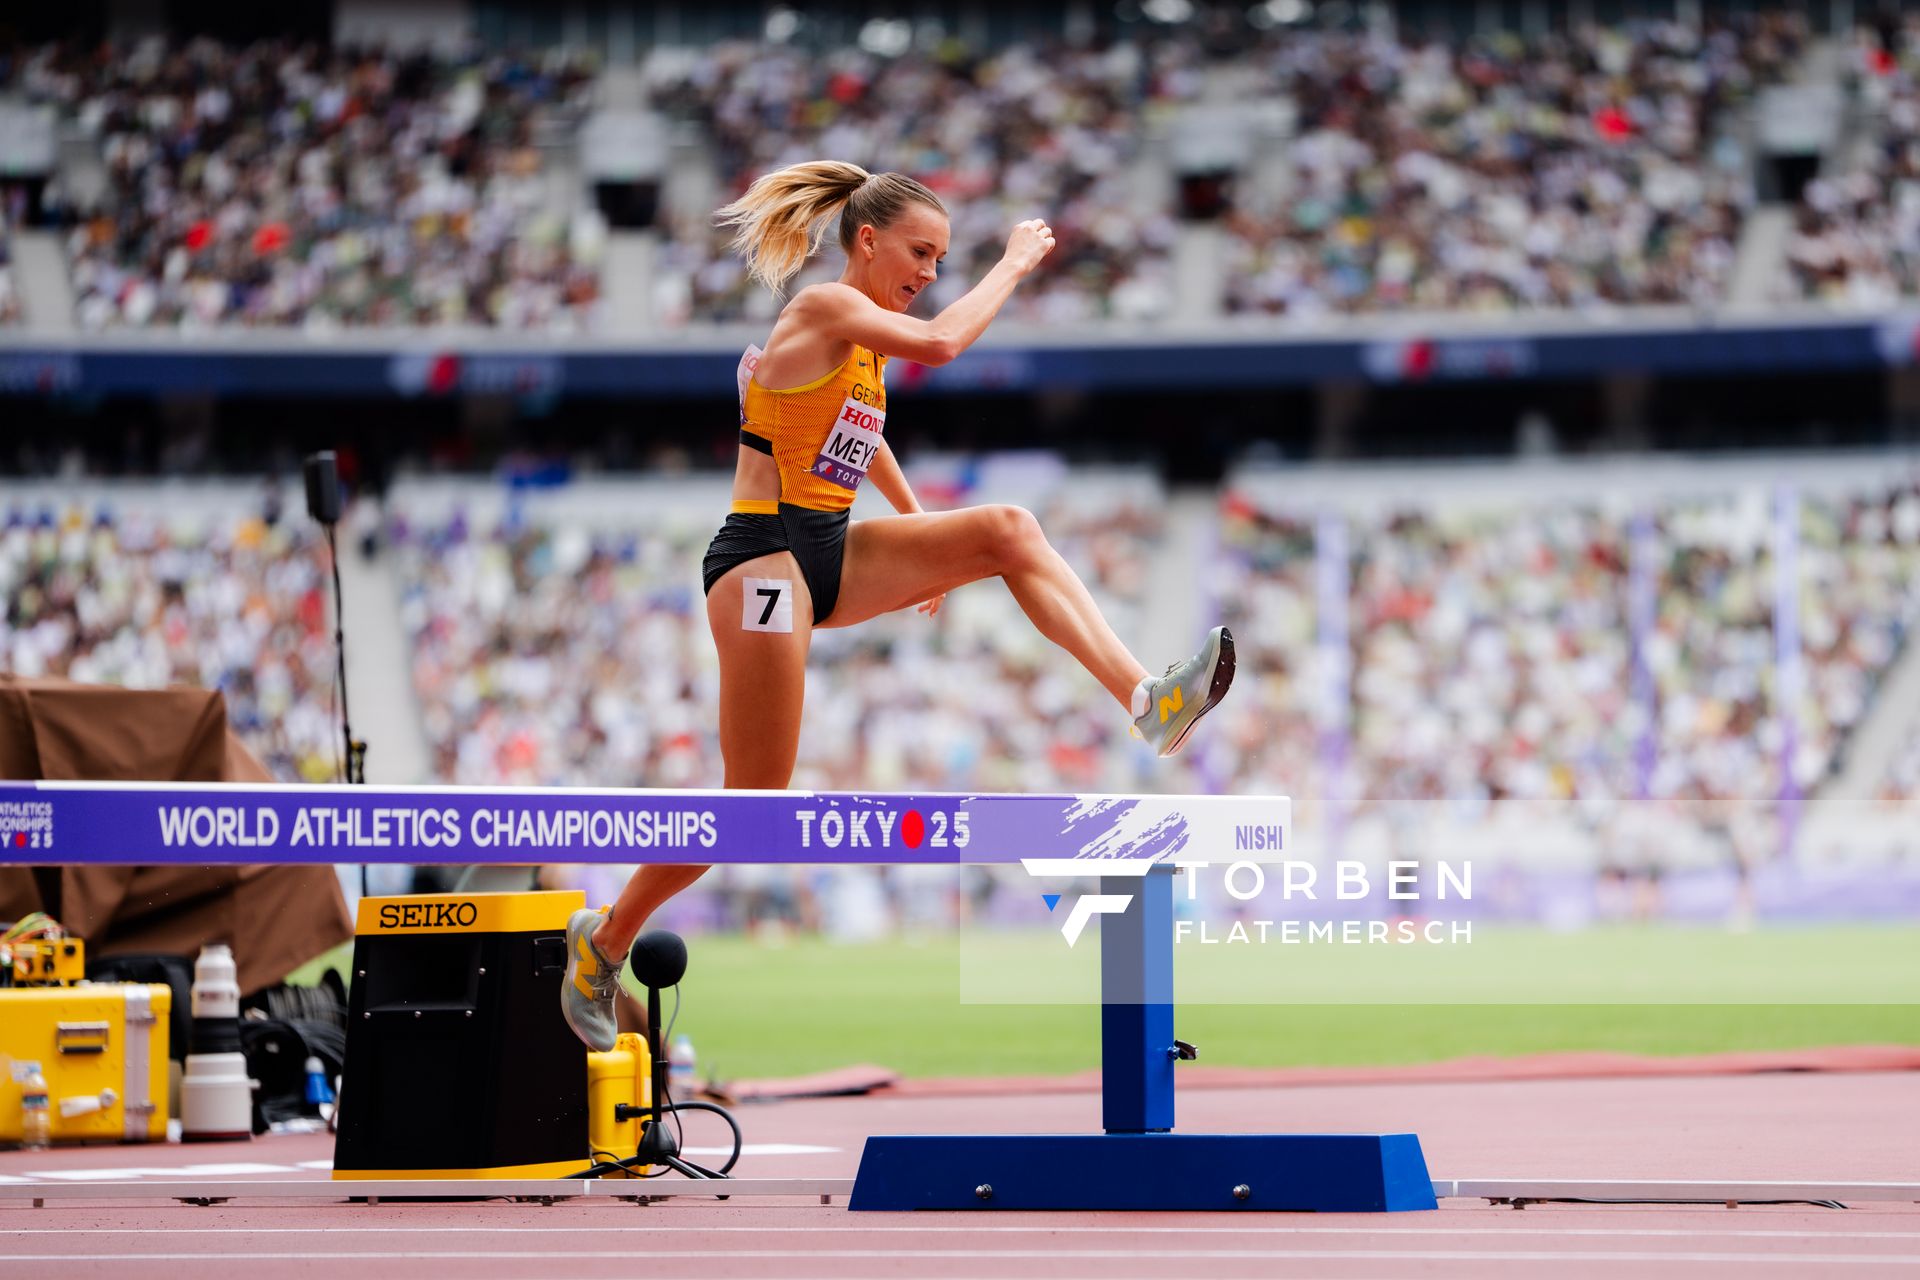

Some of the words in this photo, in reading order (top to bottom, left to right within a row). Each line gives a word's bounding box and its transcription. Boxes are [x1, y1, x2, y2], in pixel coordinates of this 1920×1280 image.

[757, 589, 781, 625] 7
[158, 806, 280, 847] WORLD
[290, 807, 462, 847] ATHLETICS
[471, 808, 717, 848] CHAMPIONSHIPS
[1236, 825, 1283, 850] NISHI
[380, 902, 477, 928] SEIKO
